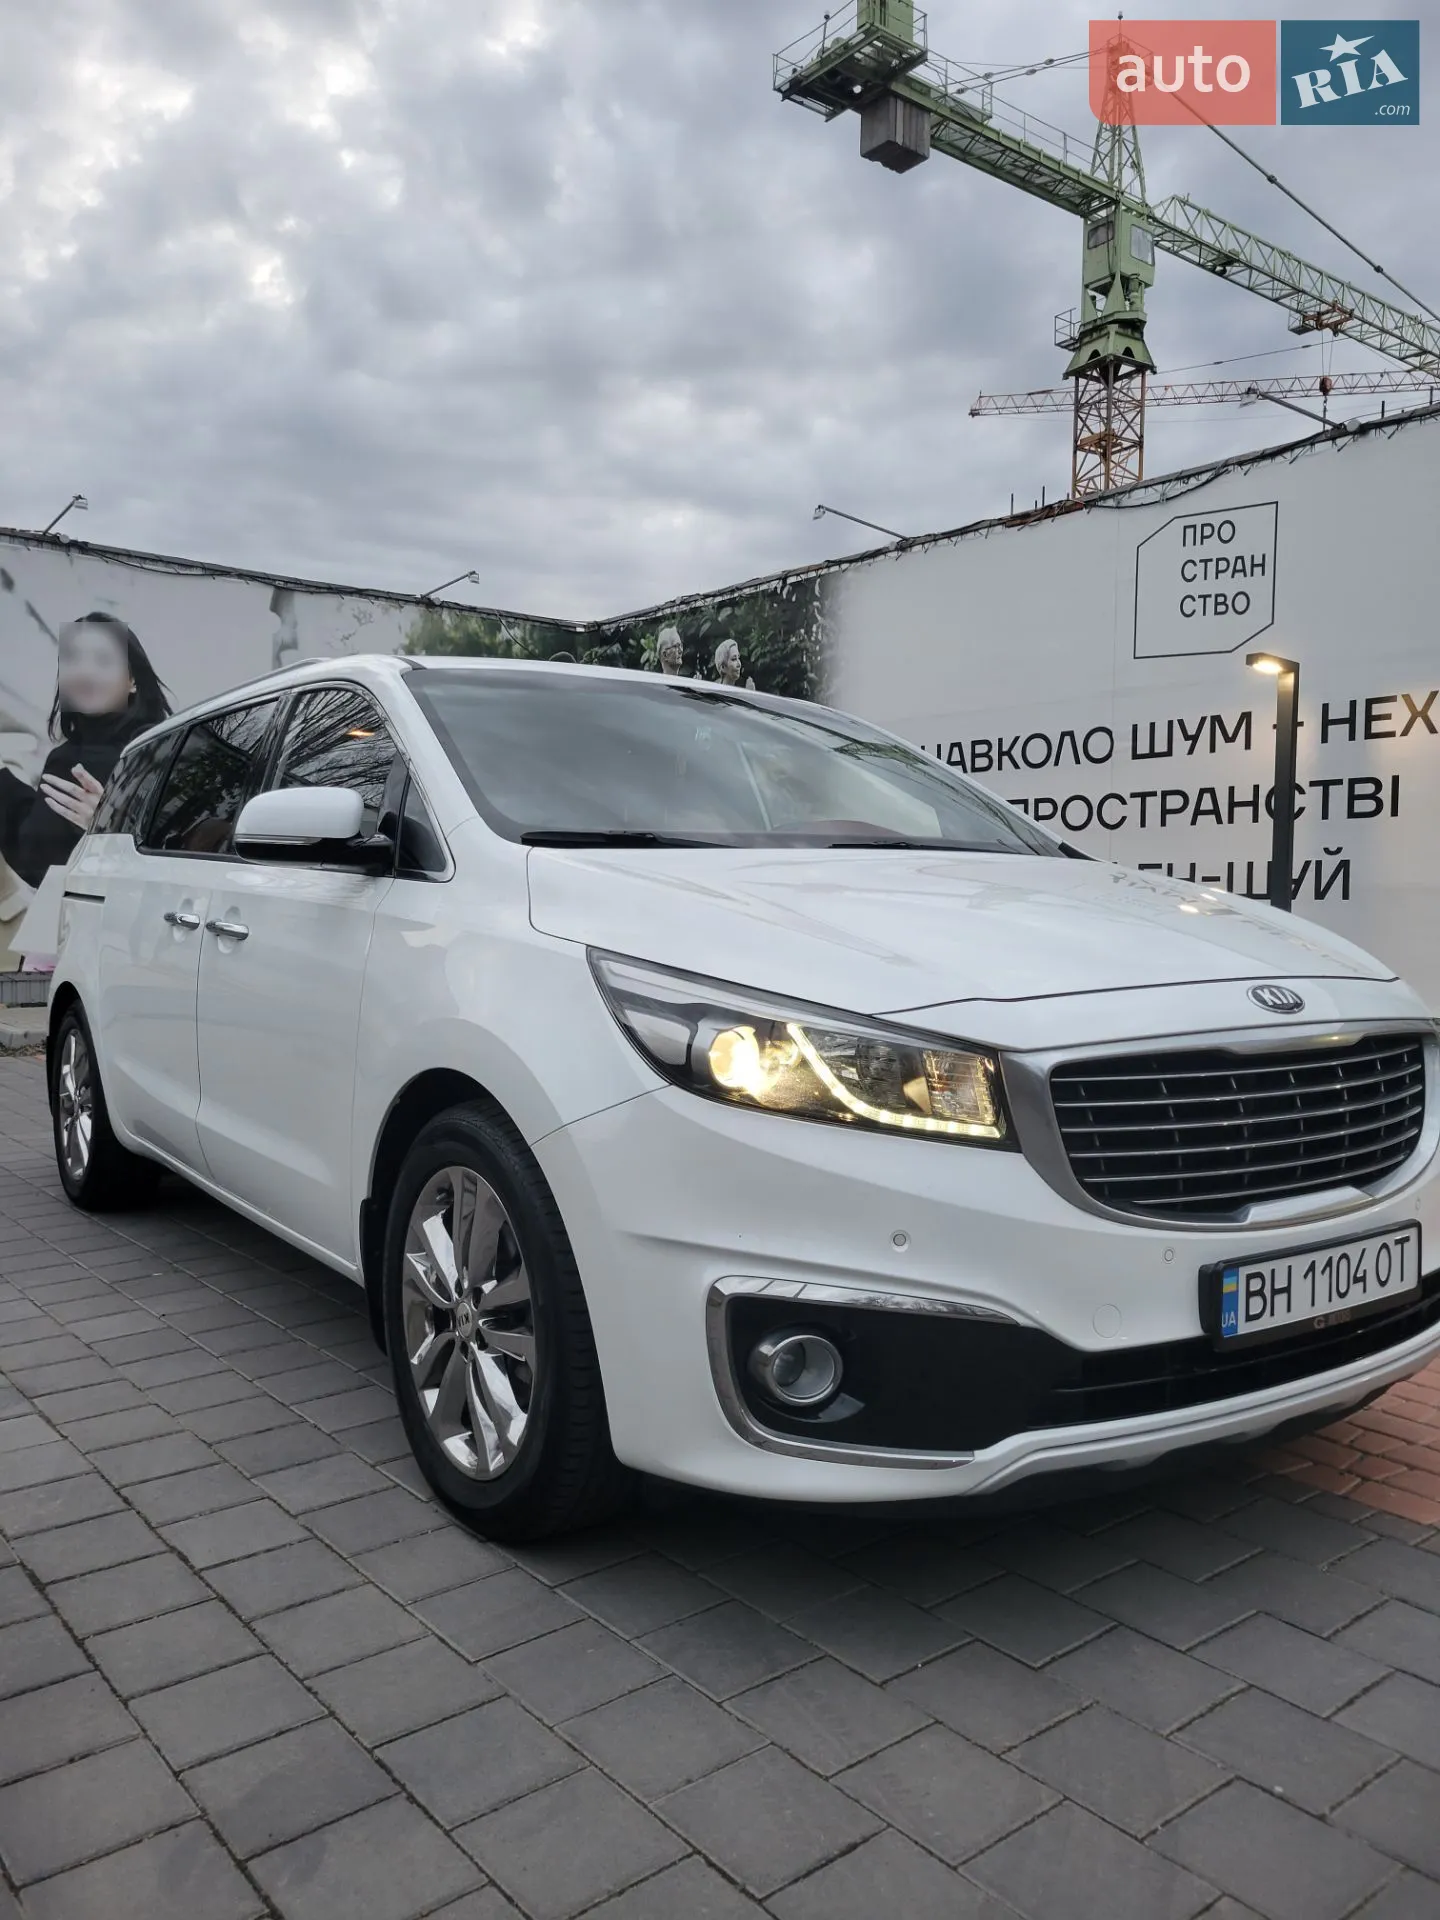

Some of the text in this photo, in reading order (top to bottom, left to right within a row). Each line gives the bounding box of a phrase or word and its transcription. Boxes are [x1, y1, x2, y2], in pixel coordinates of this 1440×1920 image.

[1182, 519, 1236, 548] ПРО
[1180, 553, 1267, 583] СТРАН
[1180, 590, 1251, 618] СТВО
[1131, 710, 1253, 761] ШУМ
[1320, 690, 1440, 745] НЕХ
[1244, 1265, 1293, 1323] BH
[1303, 1248, 1367, 1307] 1104
[1221, 1311, 1237, 1328] UA
